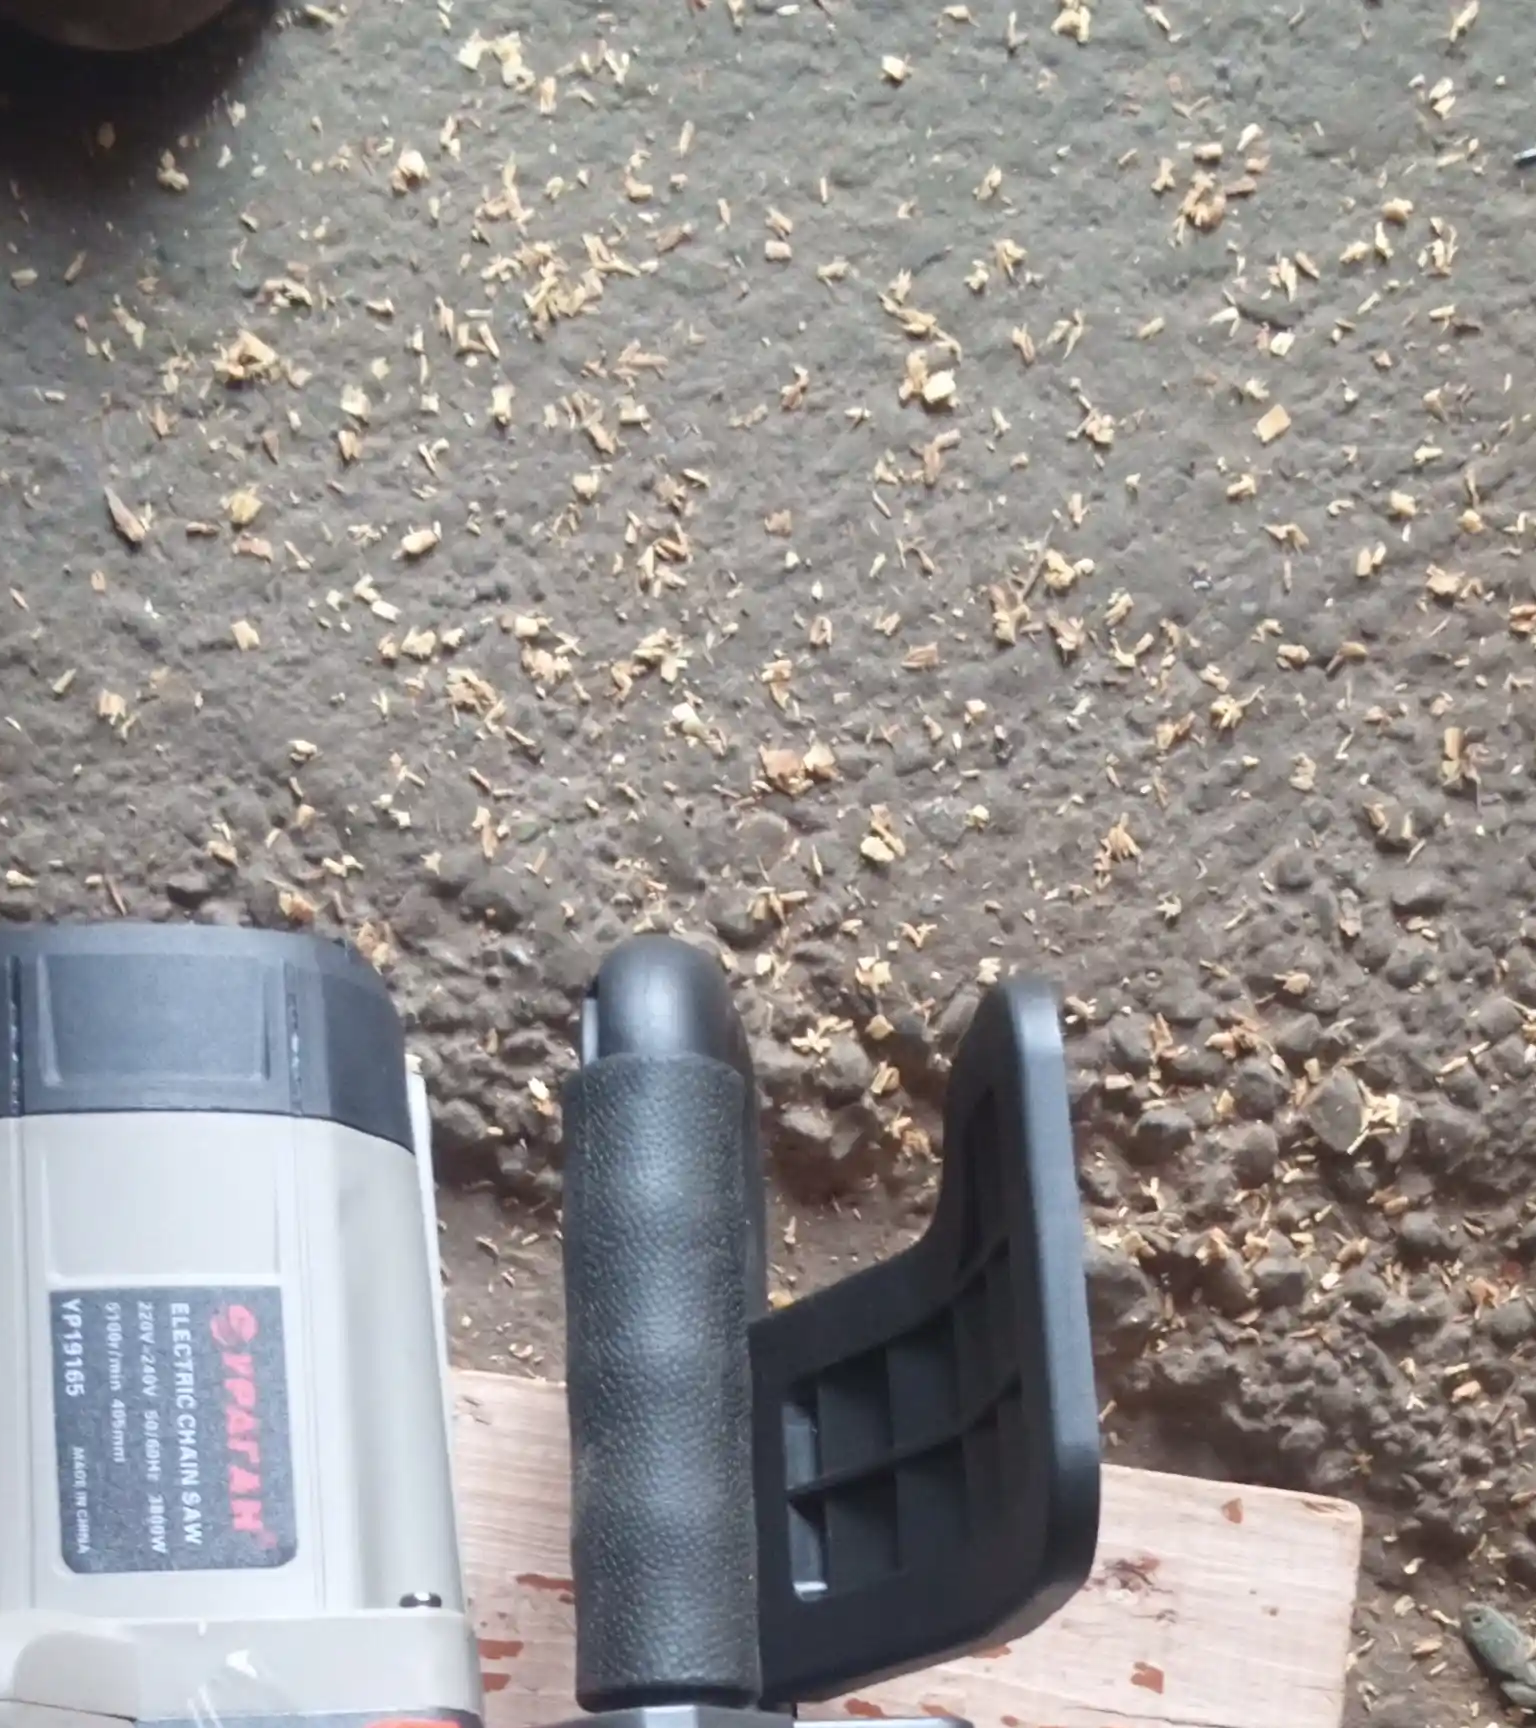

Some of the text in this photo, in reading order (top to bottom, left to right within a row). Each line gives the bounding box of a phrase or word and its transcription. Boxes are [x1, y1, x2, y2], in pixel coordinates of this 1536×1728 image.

[72, 1446, 91, 1554] MADE IN CHINA
[170, 1302, 204, 1545] ELECTRIC CHAIN SAW
